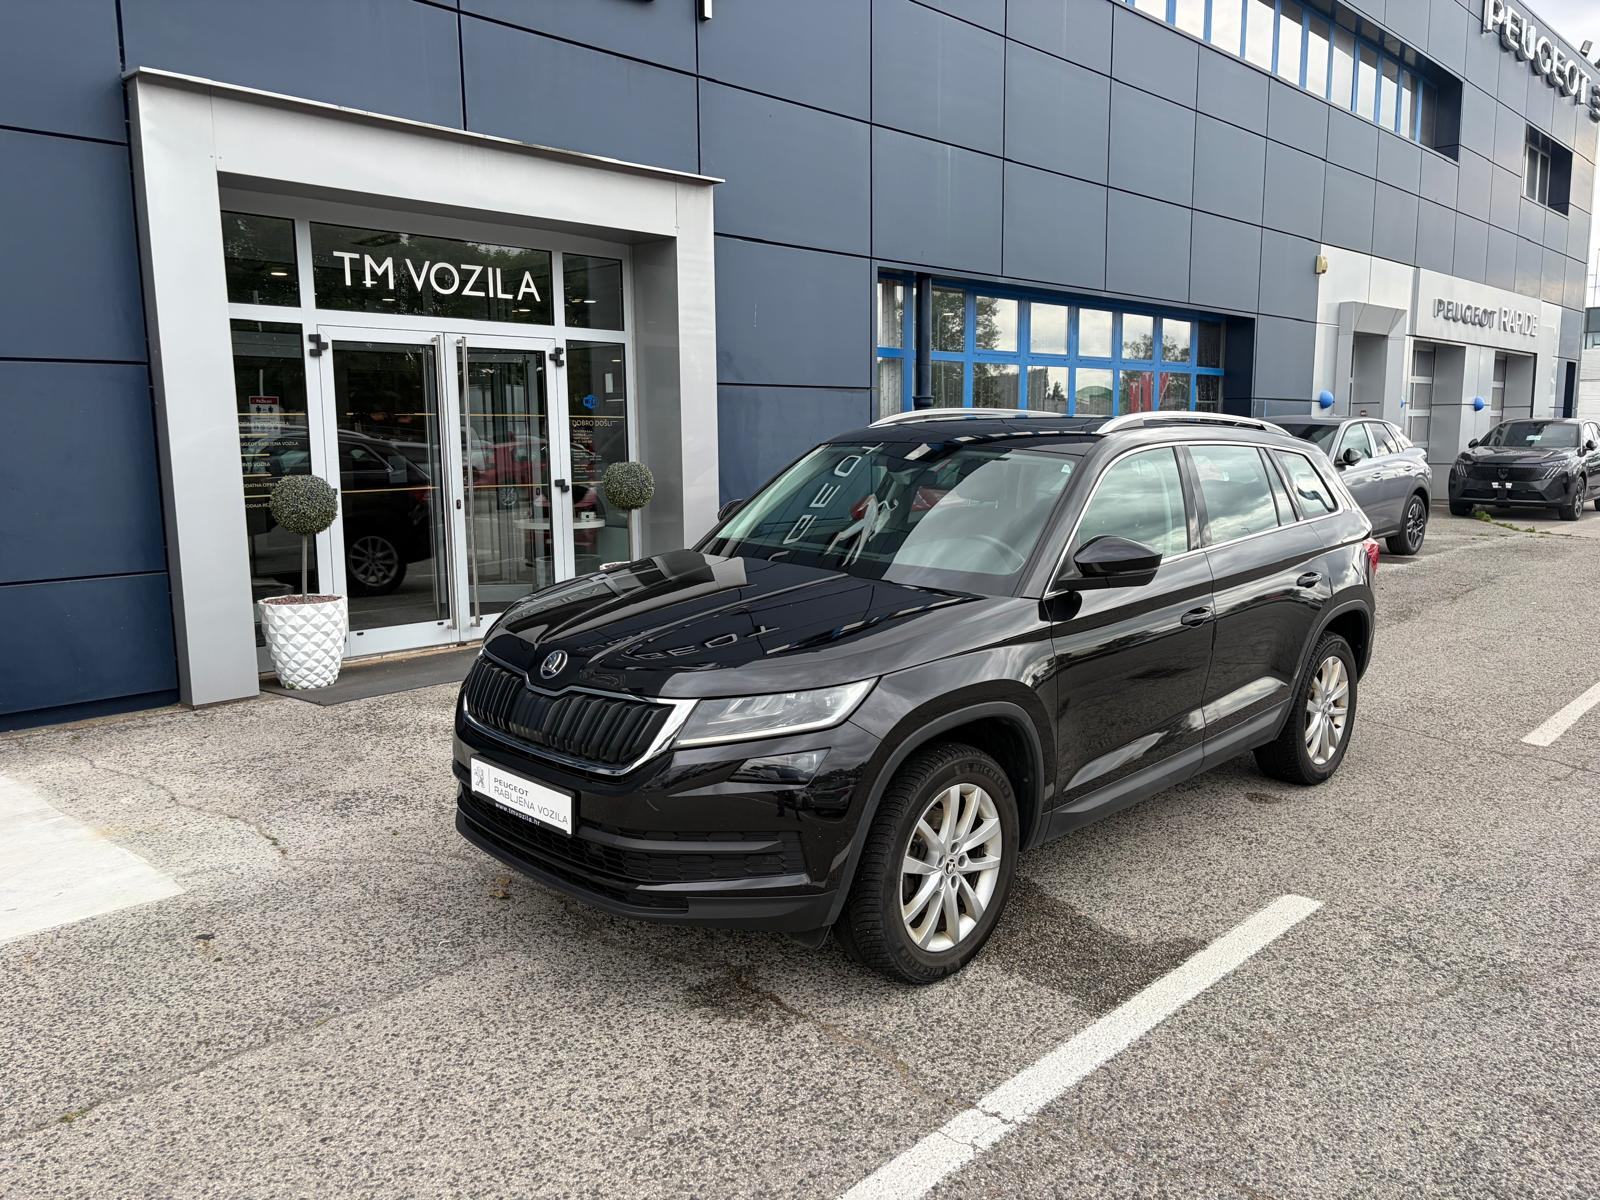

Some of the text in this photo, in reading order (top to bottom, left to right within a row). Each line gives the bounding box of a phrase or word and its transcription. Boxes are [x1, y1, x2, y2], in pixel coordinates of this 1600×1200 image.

[1481, 0, 1592, 105] PEUGEOT
[333, 251, 541, 302] TM VOZILA
[1433, 298, 1538, 337] PEUGEOT RAPIDE
[493, 777, 529, 797] PEUGEOT
[494, 786, 569, 825] RABLJENA VOZILA
[495, 802, 541, 826] www.tmvozila.hr
